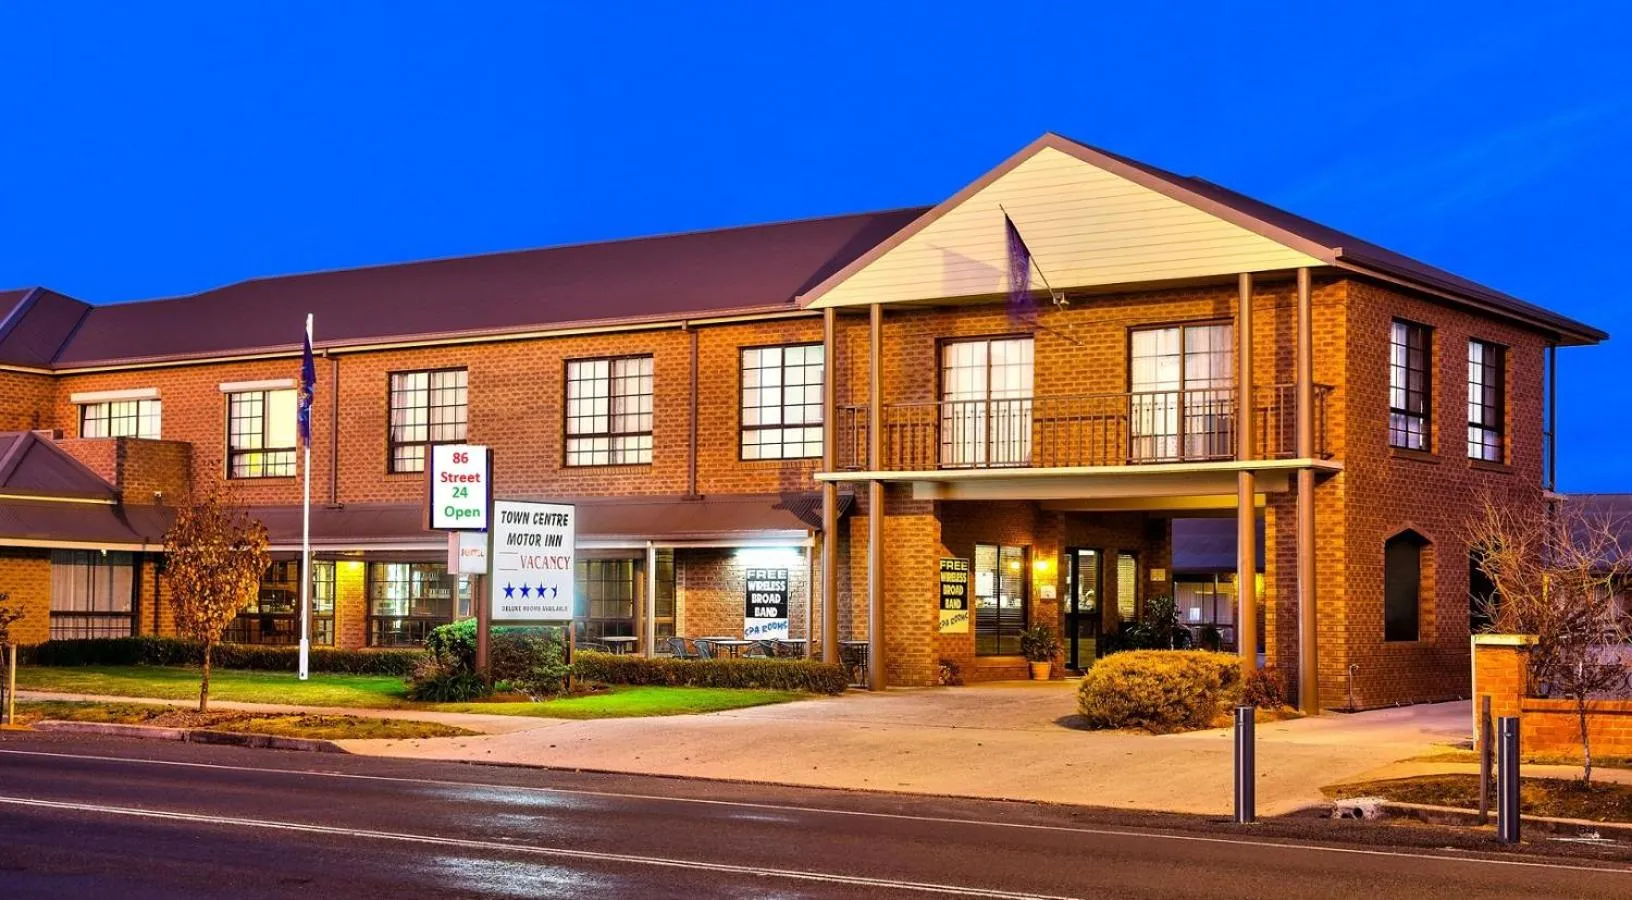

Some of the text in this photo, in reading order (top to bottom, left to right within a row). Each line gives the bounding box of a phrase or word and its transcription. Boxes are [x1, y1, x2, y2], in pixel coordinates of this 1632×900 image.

[453, 452, 469, 464] 86
[440, 471, 481, 483] Street
[452, 487, 468, 498] 24
[444, 506, 481, 520] Open
[501, 510, 569, 527] TOWN CENTRE
[506, 532, 563, 547] MOTOR INN
[520, 555, 571, 570] VACANCY
[940, 560, 968, 571] FREE
[747, 569, 788, 580] FREE
[747, 580, 786, 592] WIRELESS
[751, 593, 781, 604] BROAD
[754, 607, 778, 618] BAND
[744, 620, 788, 637] SPA ROOMS
